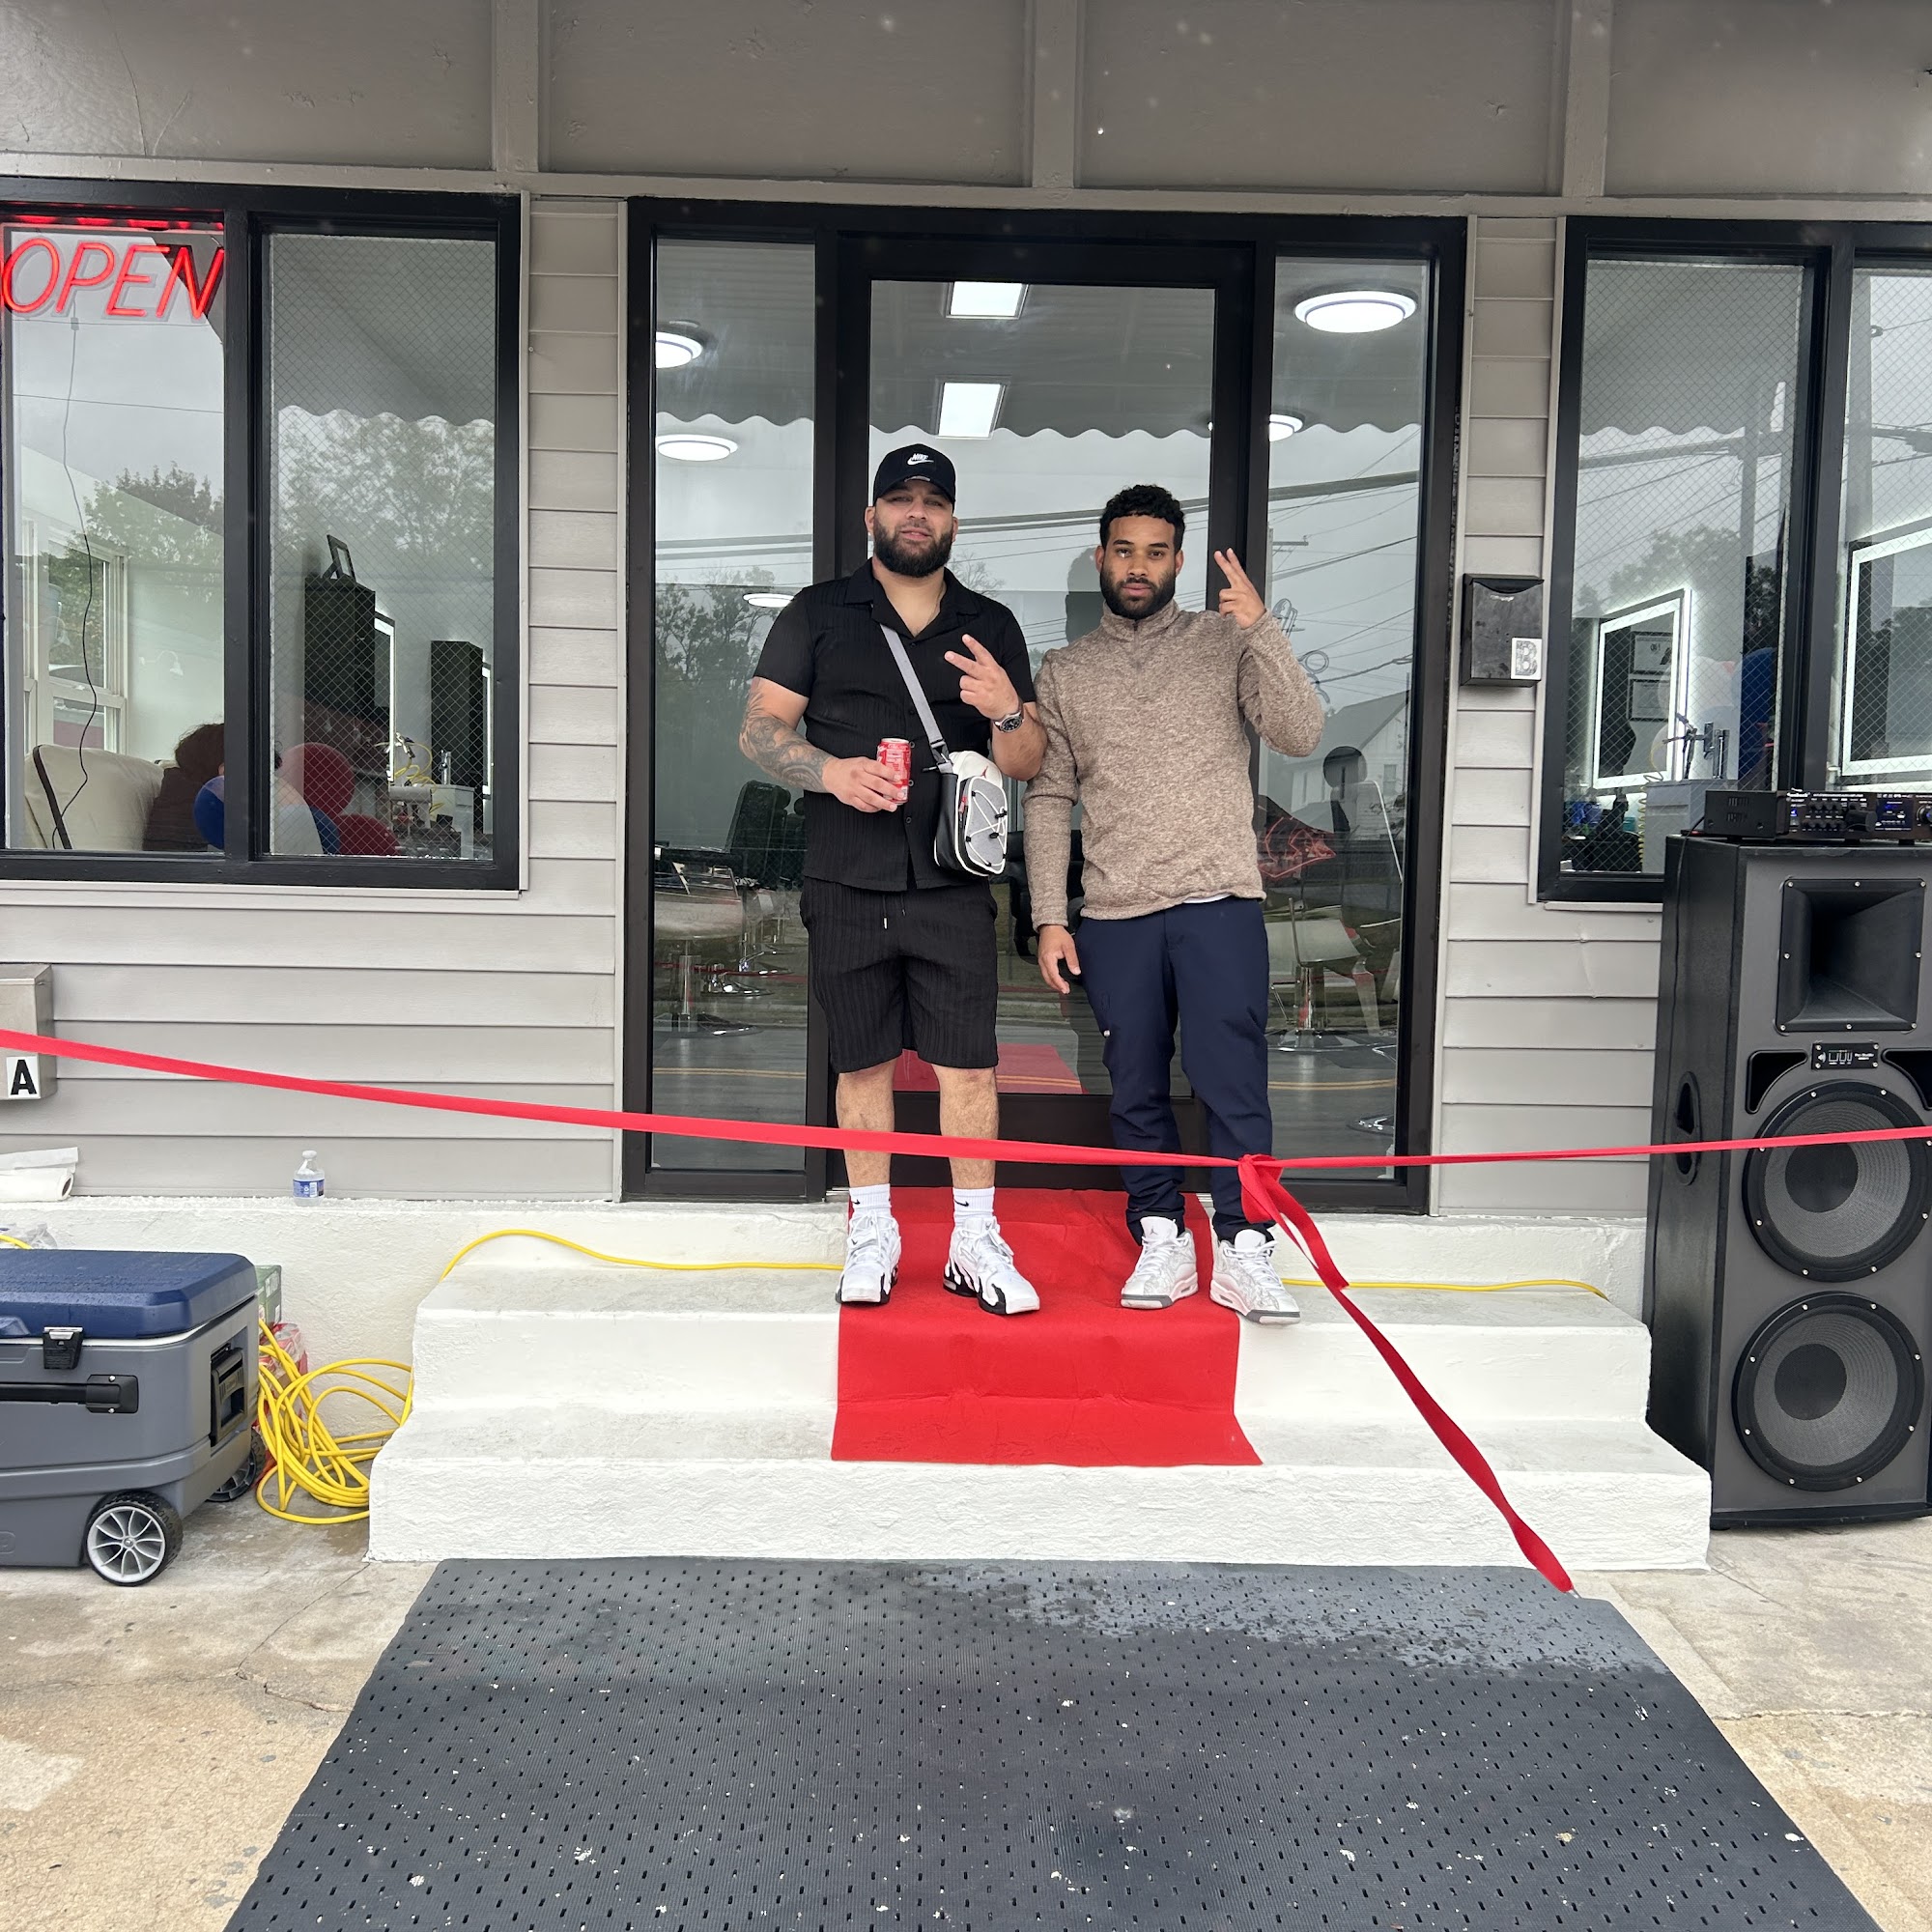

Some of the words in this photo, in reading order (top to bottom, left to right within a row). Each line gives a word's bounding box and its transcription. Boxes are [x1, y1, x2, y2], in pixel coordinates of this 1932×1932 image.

[2, 238, 225, 319] OPEN
[911, 452, 929, 462] NIKE
[1514, 639, 1538, 676] B
[10, 1059, 38, 1095] A
